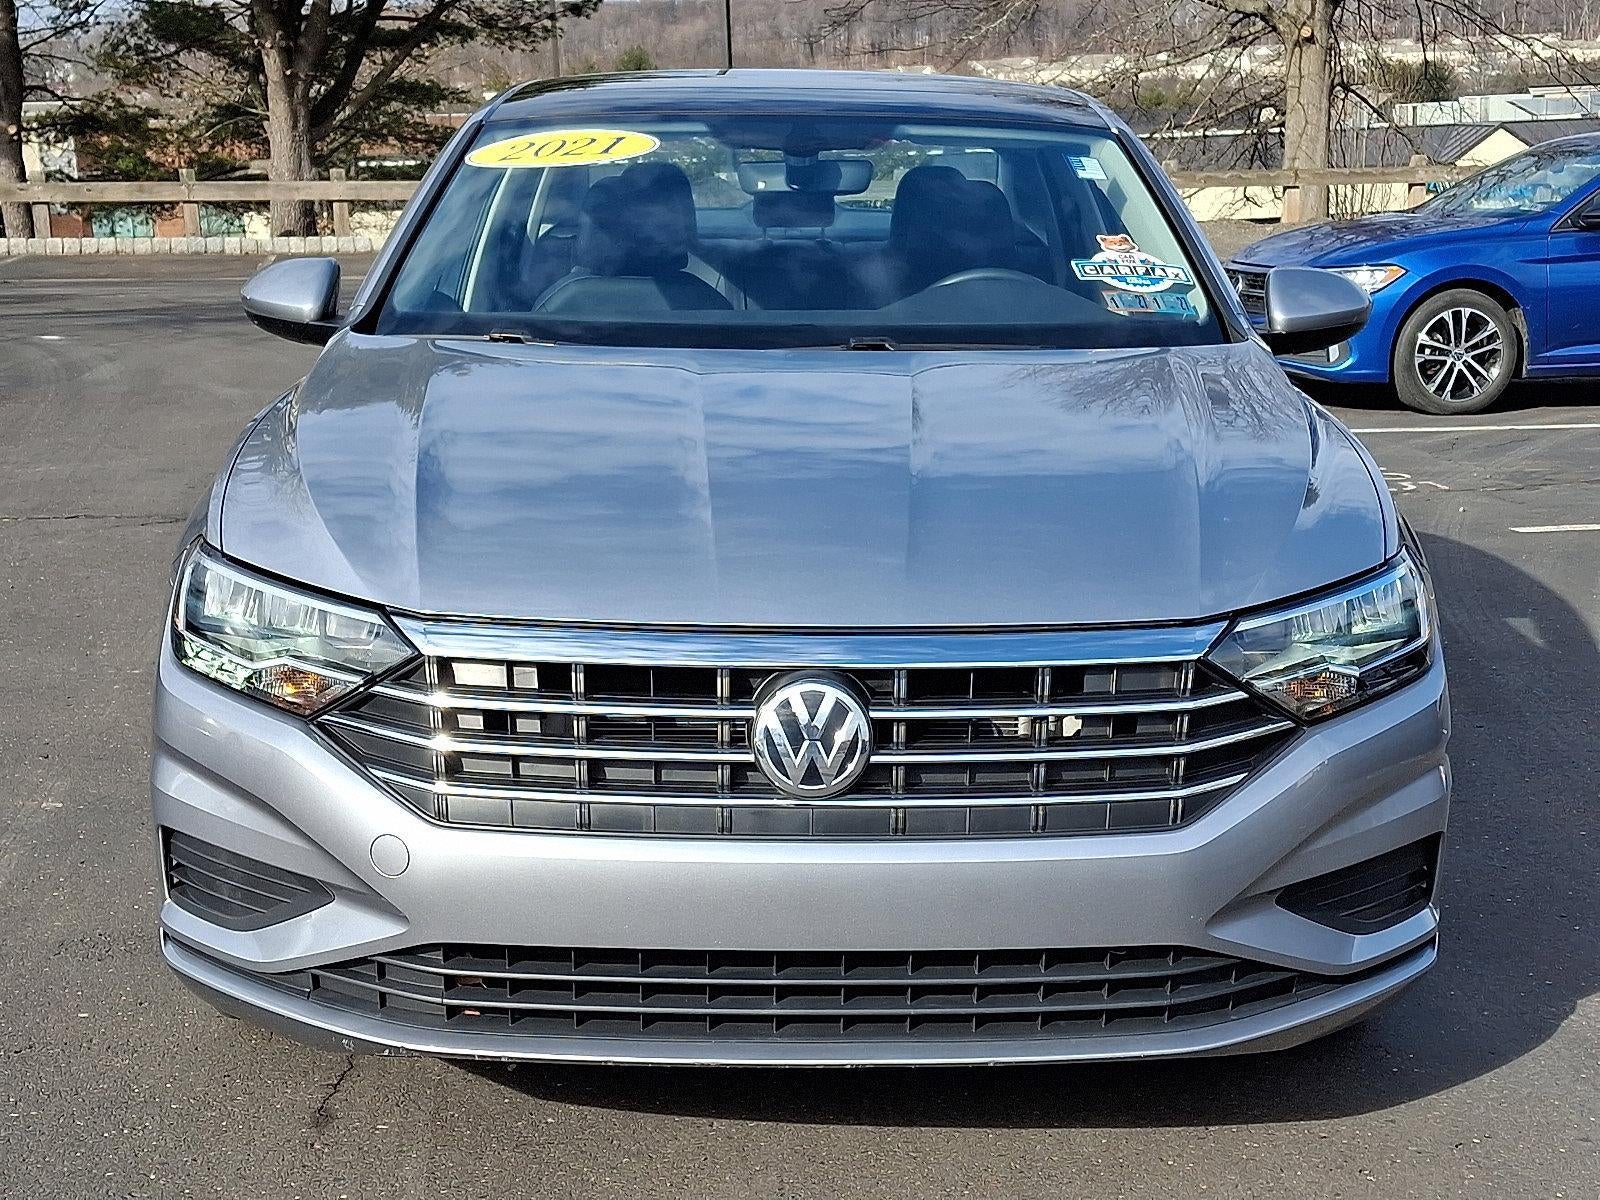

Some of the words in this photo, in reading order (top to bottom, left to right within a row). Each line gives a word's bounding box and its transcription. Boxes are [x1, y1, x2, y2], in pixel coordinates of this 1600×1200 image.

[498, 136, 626, 162] 2021
[1081, 264, 1182, 280] CARFAX
[756, 681, 868, 793] VW
